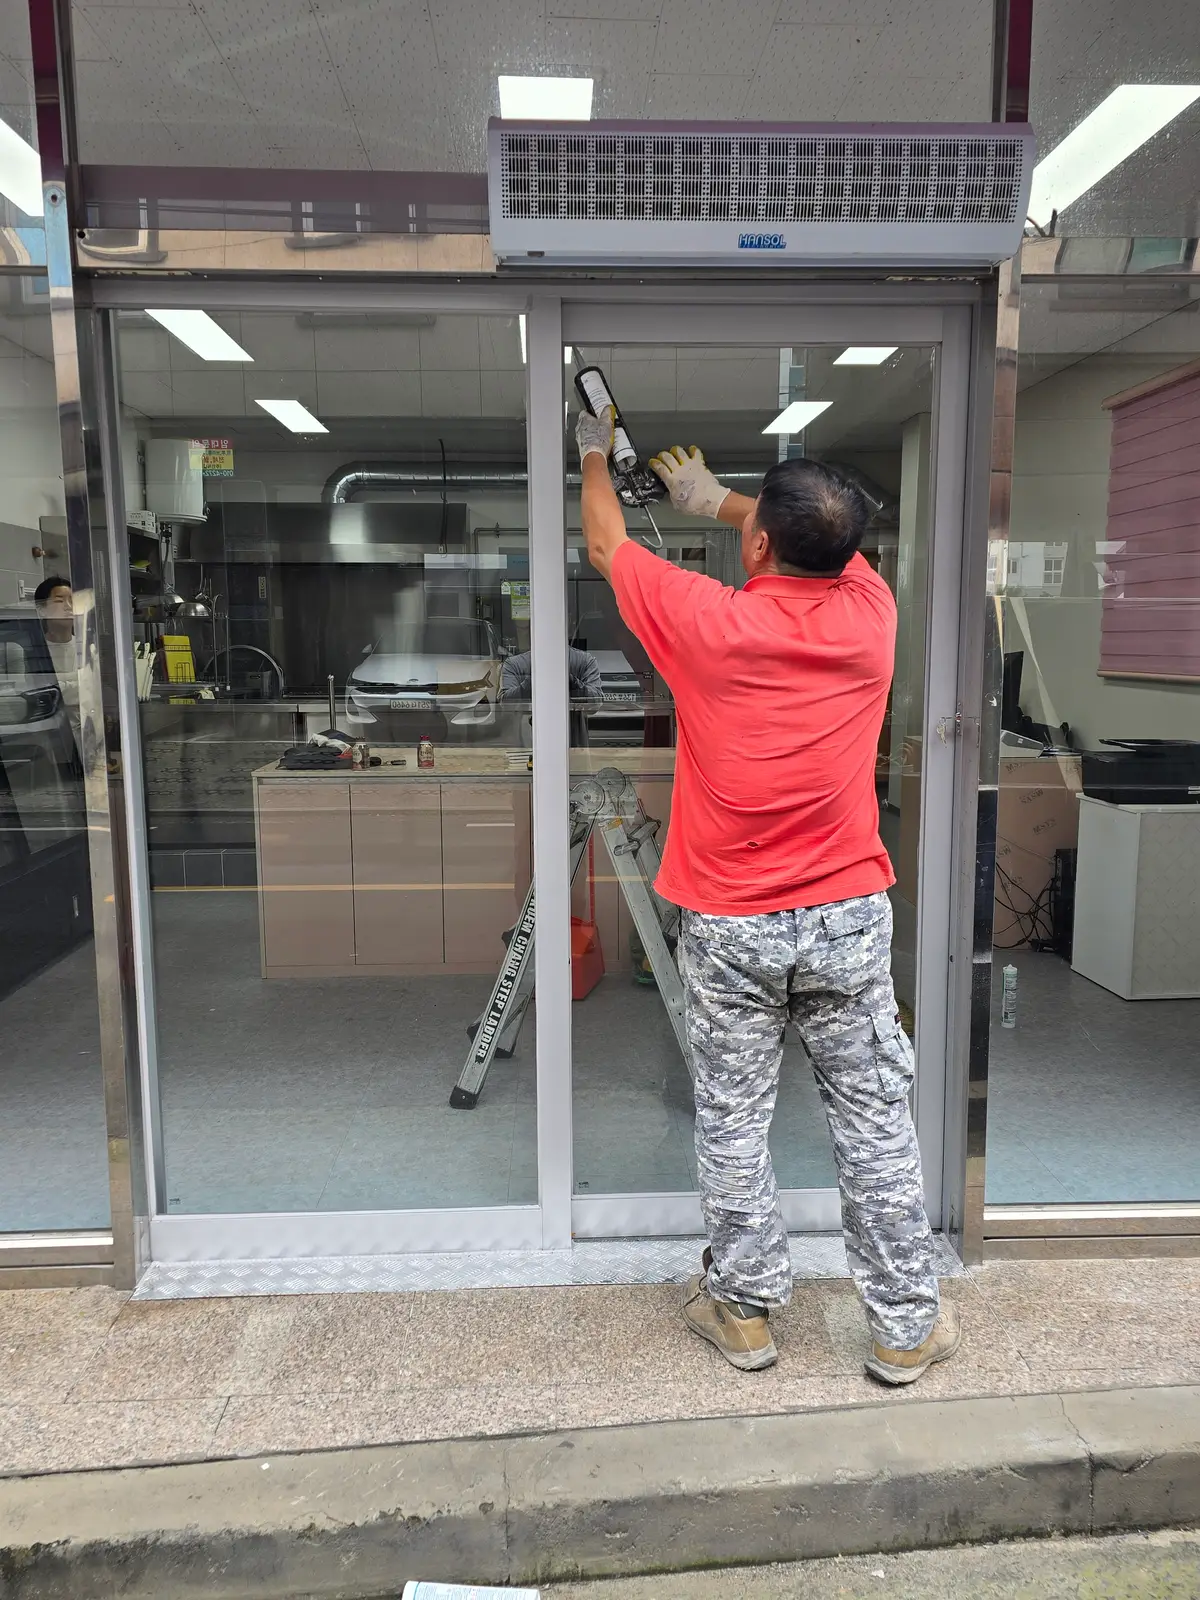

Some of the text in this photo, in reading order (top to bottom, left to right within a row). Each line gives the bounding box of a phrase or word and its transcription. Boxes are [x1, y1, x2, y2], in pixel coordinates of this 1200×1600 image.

[739, 233, 787, 246] HANSOL
[504, 935, 527, 977] CHANG
[495, 980, 512, 1010] STEP
[477, 1010, 500, 1057] LADDER
